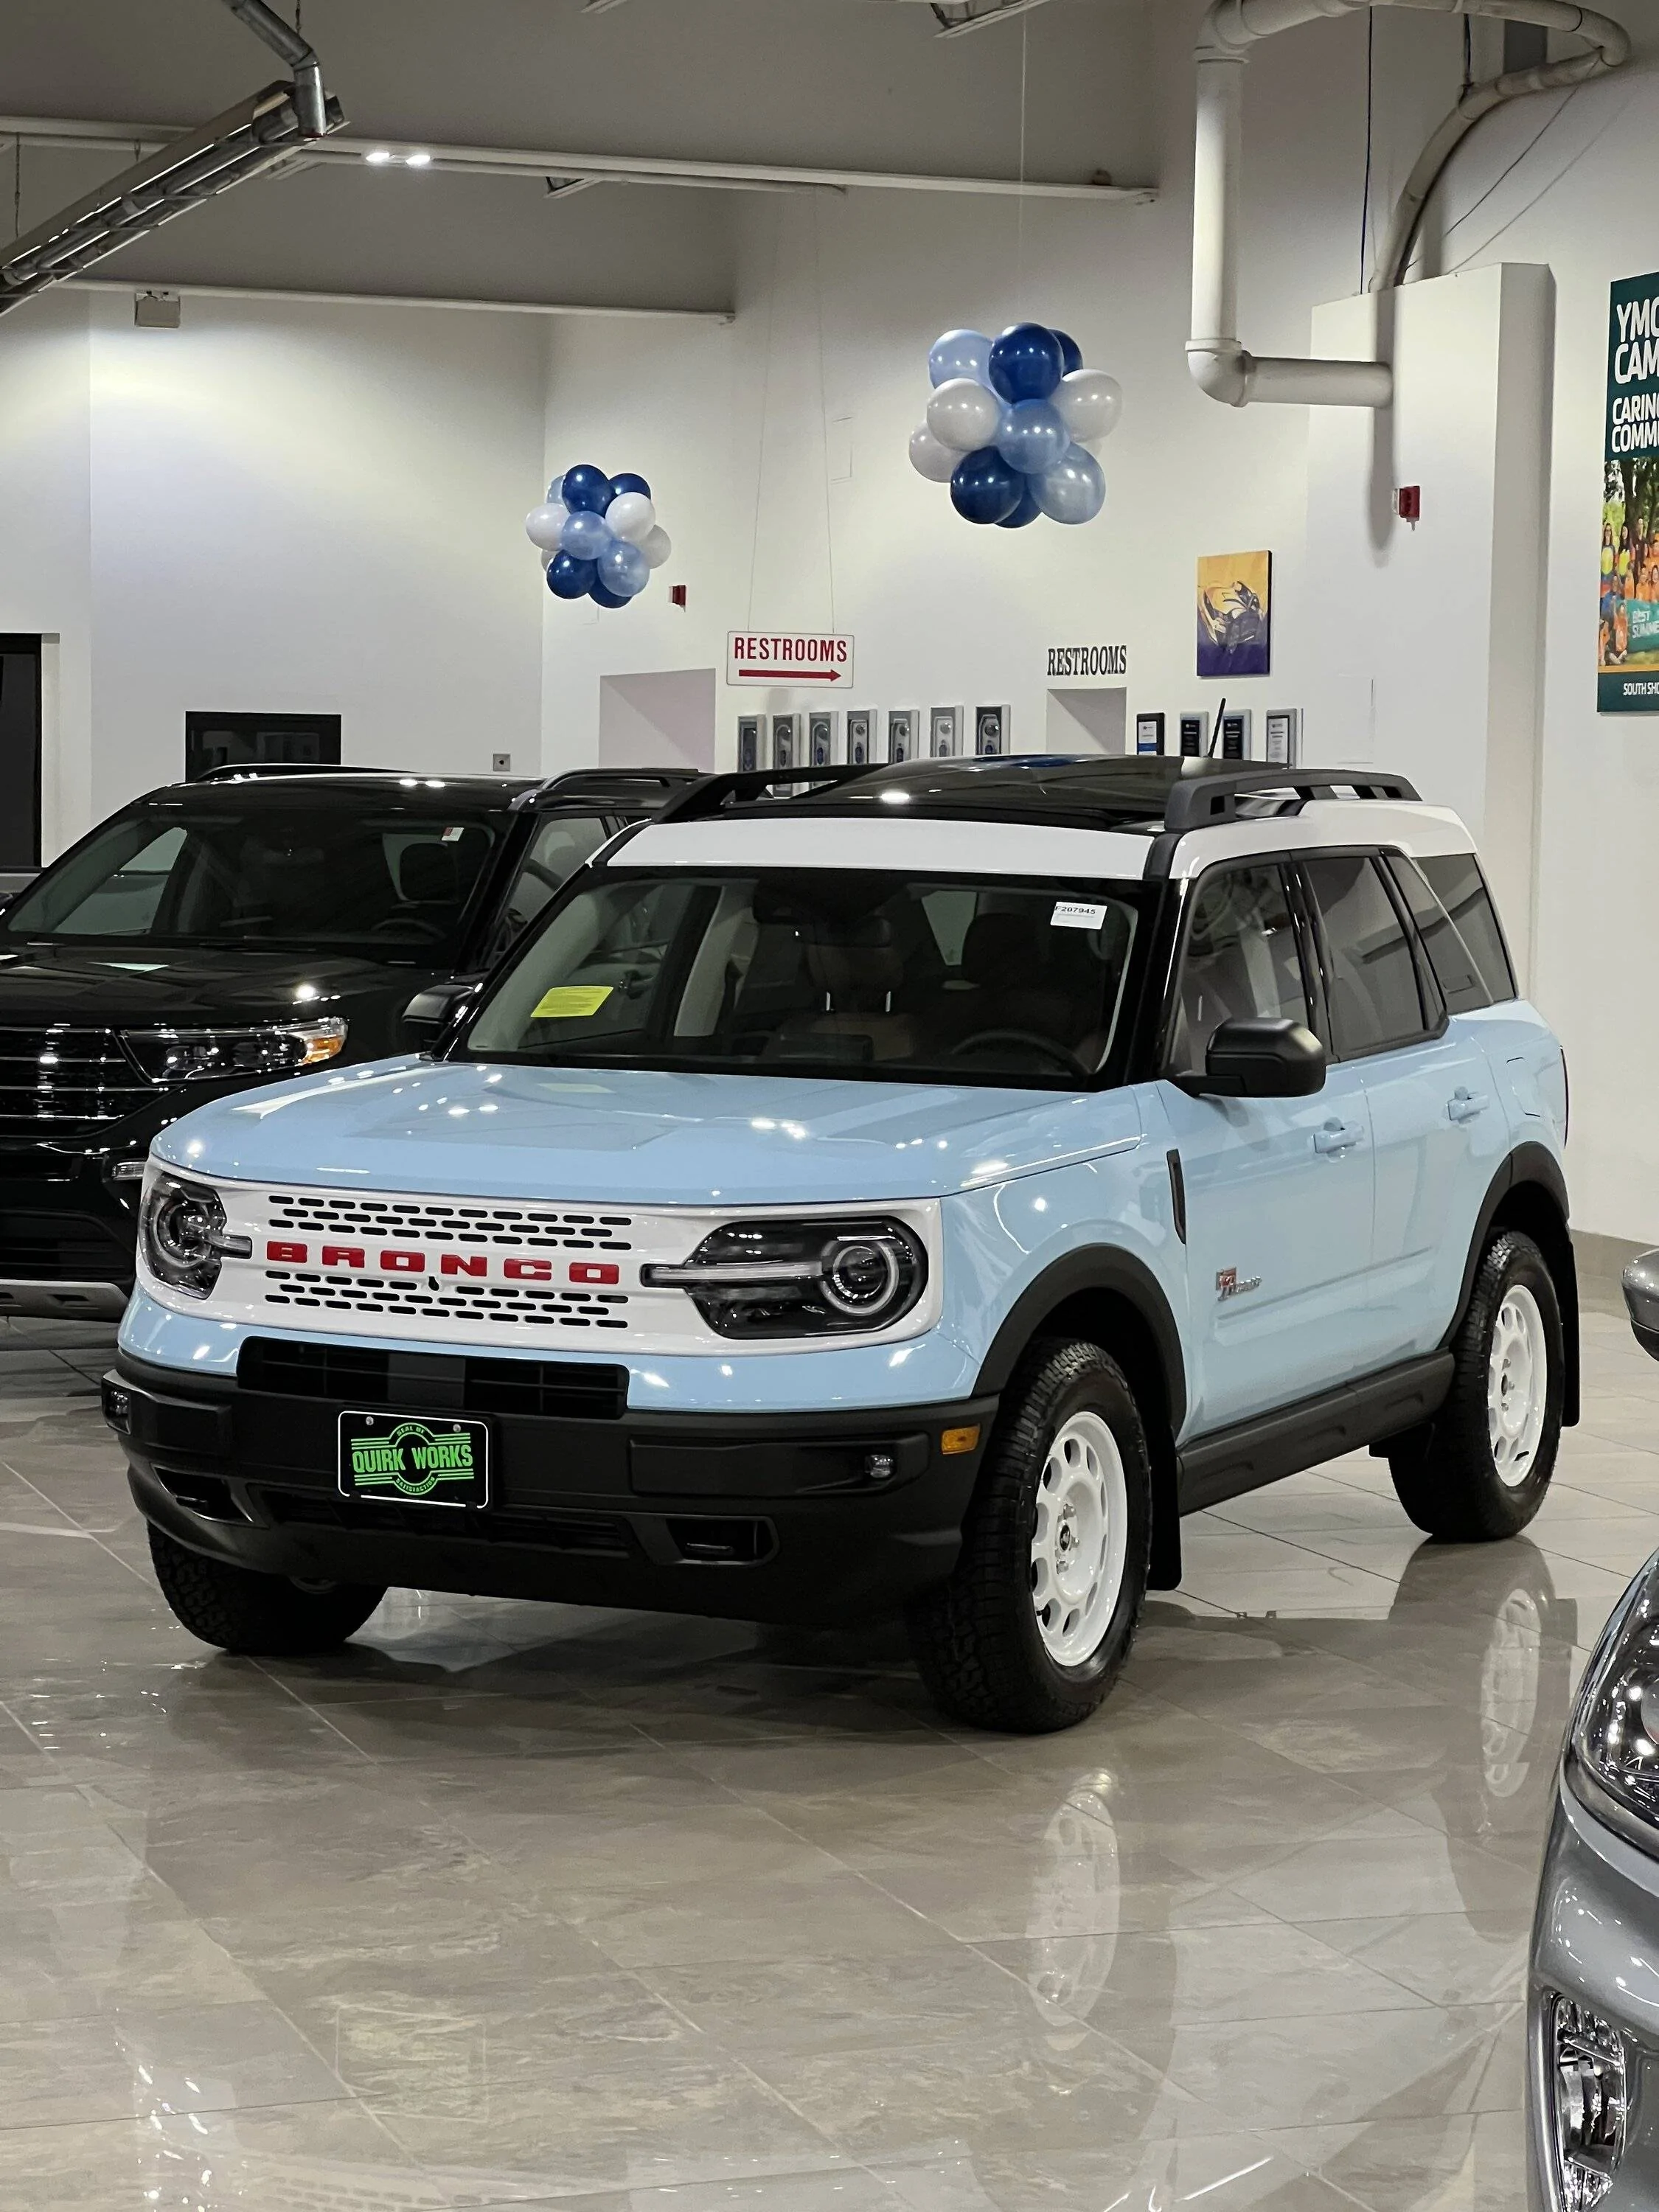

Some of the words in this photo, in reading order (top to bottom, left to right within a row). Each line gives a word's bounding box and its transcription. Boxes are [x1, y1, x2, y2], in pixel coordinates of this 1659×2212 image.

[1613, 392, 1659, 425] CARIN
[1611, 420, 1659, 453] COMM
[734, 636, 848, 663] RESTROOMS
[1047, 645, 1127, 676] RESTROOMS
[1623, 682, 1646, 695] SOUTH
[266, 1240, 619, 1284] BRONCO
[352, 1448, 406, 1473] QUIRK
[411, 1444, 473, 1470] WORKS
